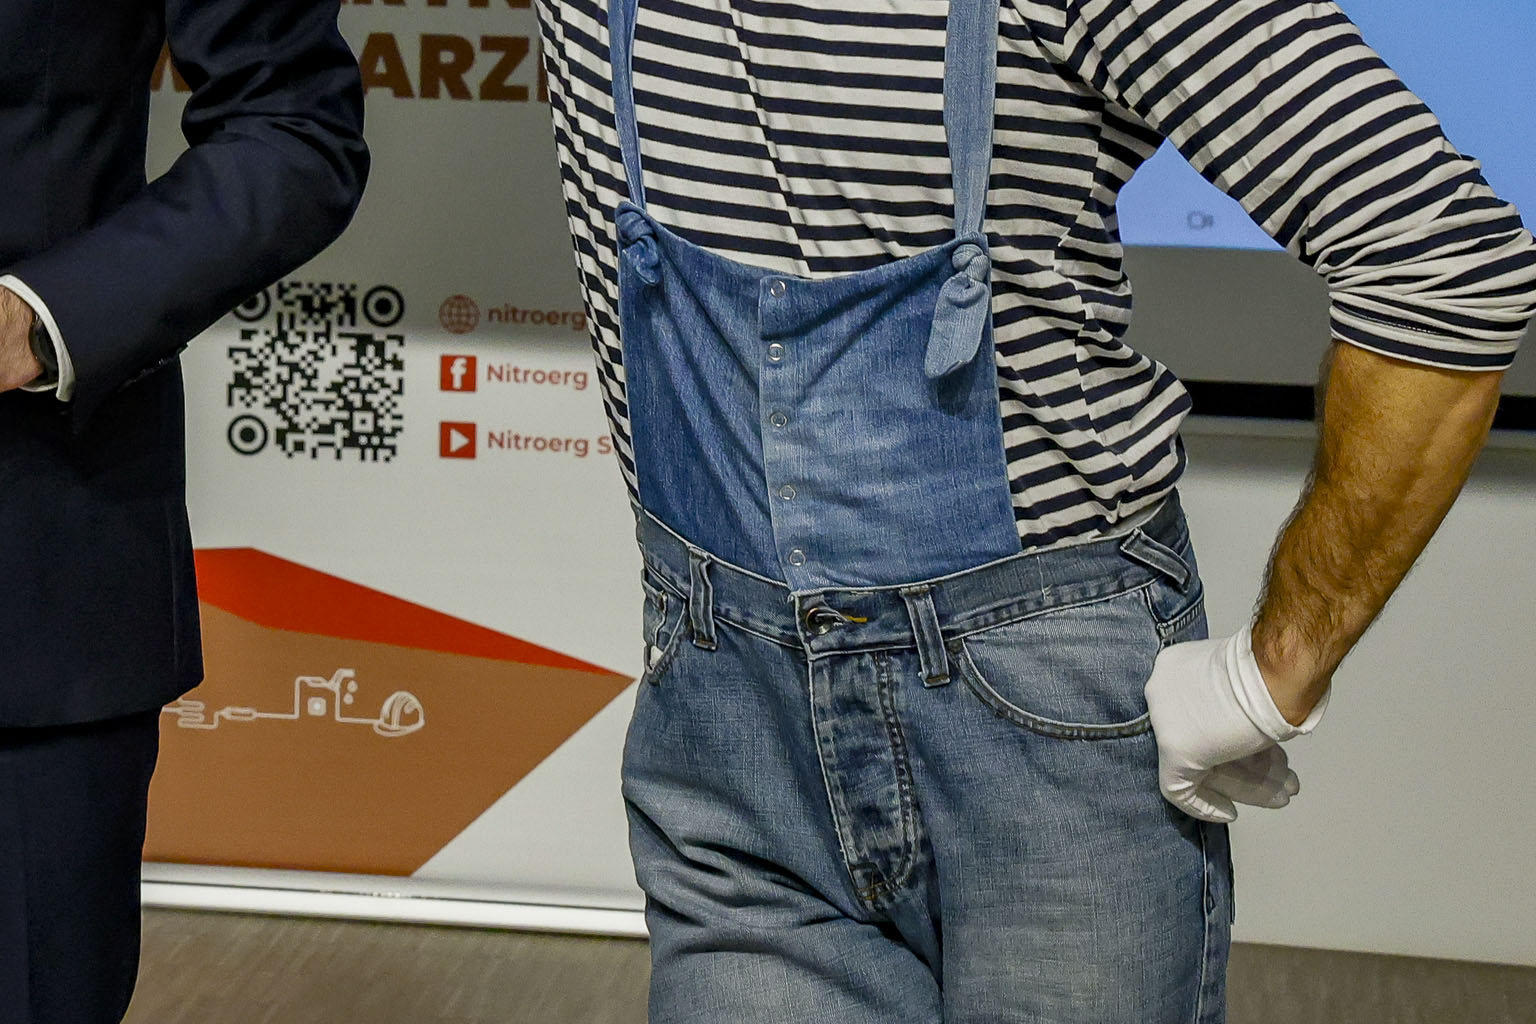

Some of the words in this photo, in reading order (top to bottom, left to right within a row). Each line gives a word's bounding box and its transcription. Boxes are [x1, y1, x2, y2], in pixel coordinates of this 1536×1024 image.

[487, 362, 589, 391] Nitroerg
[487, 430, 590, 458] Nitroerg
[596, 435, 613, 455] S
